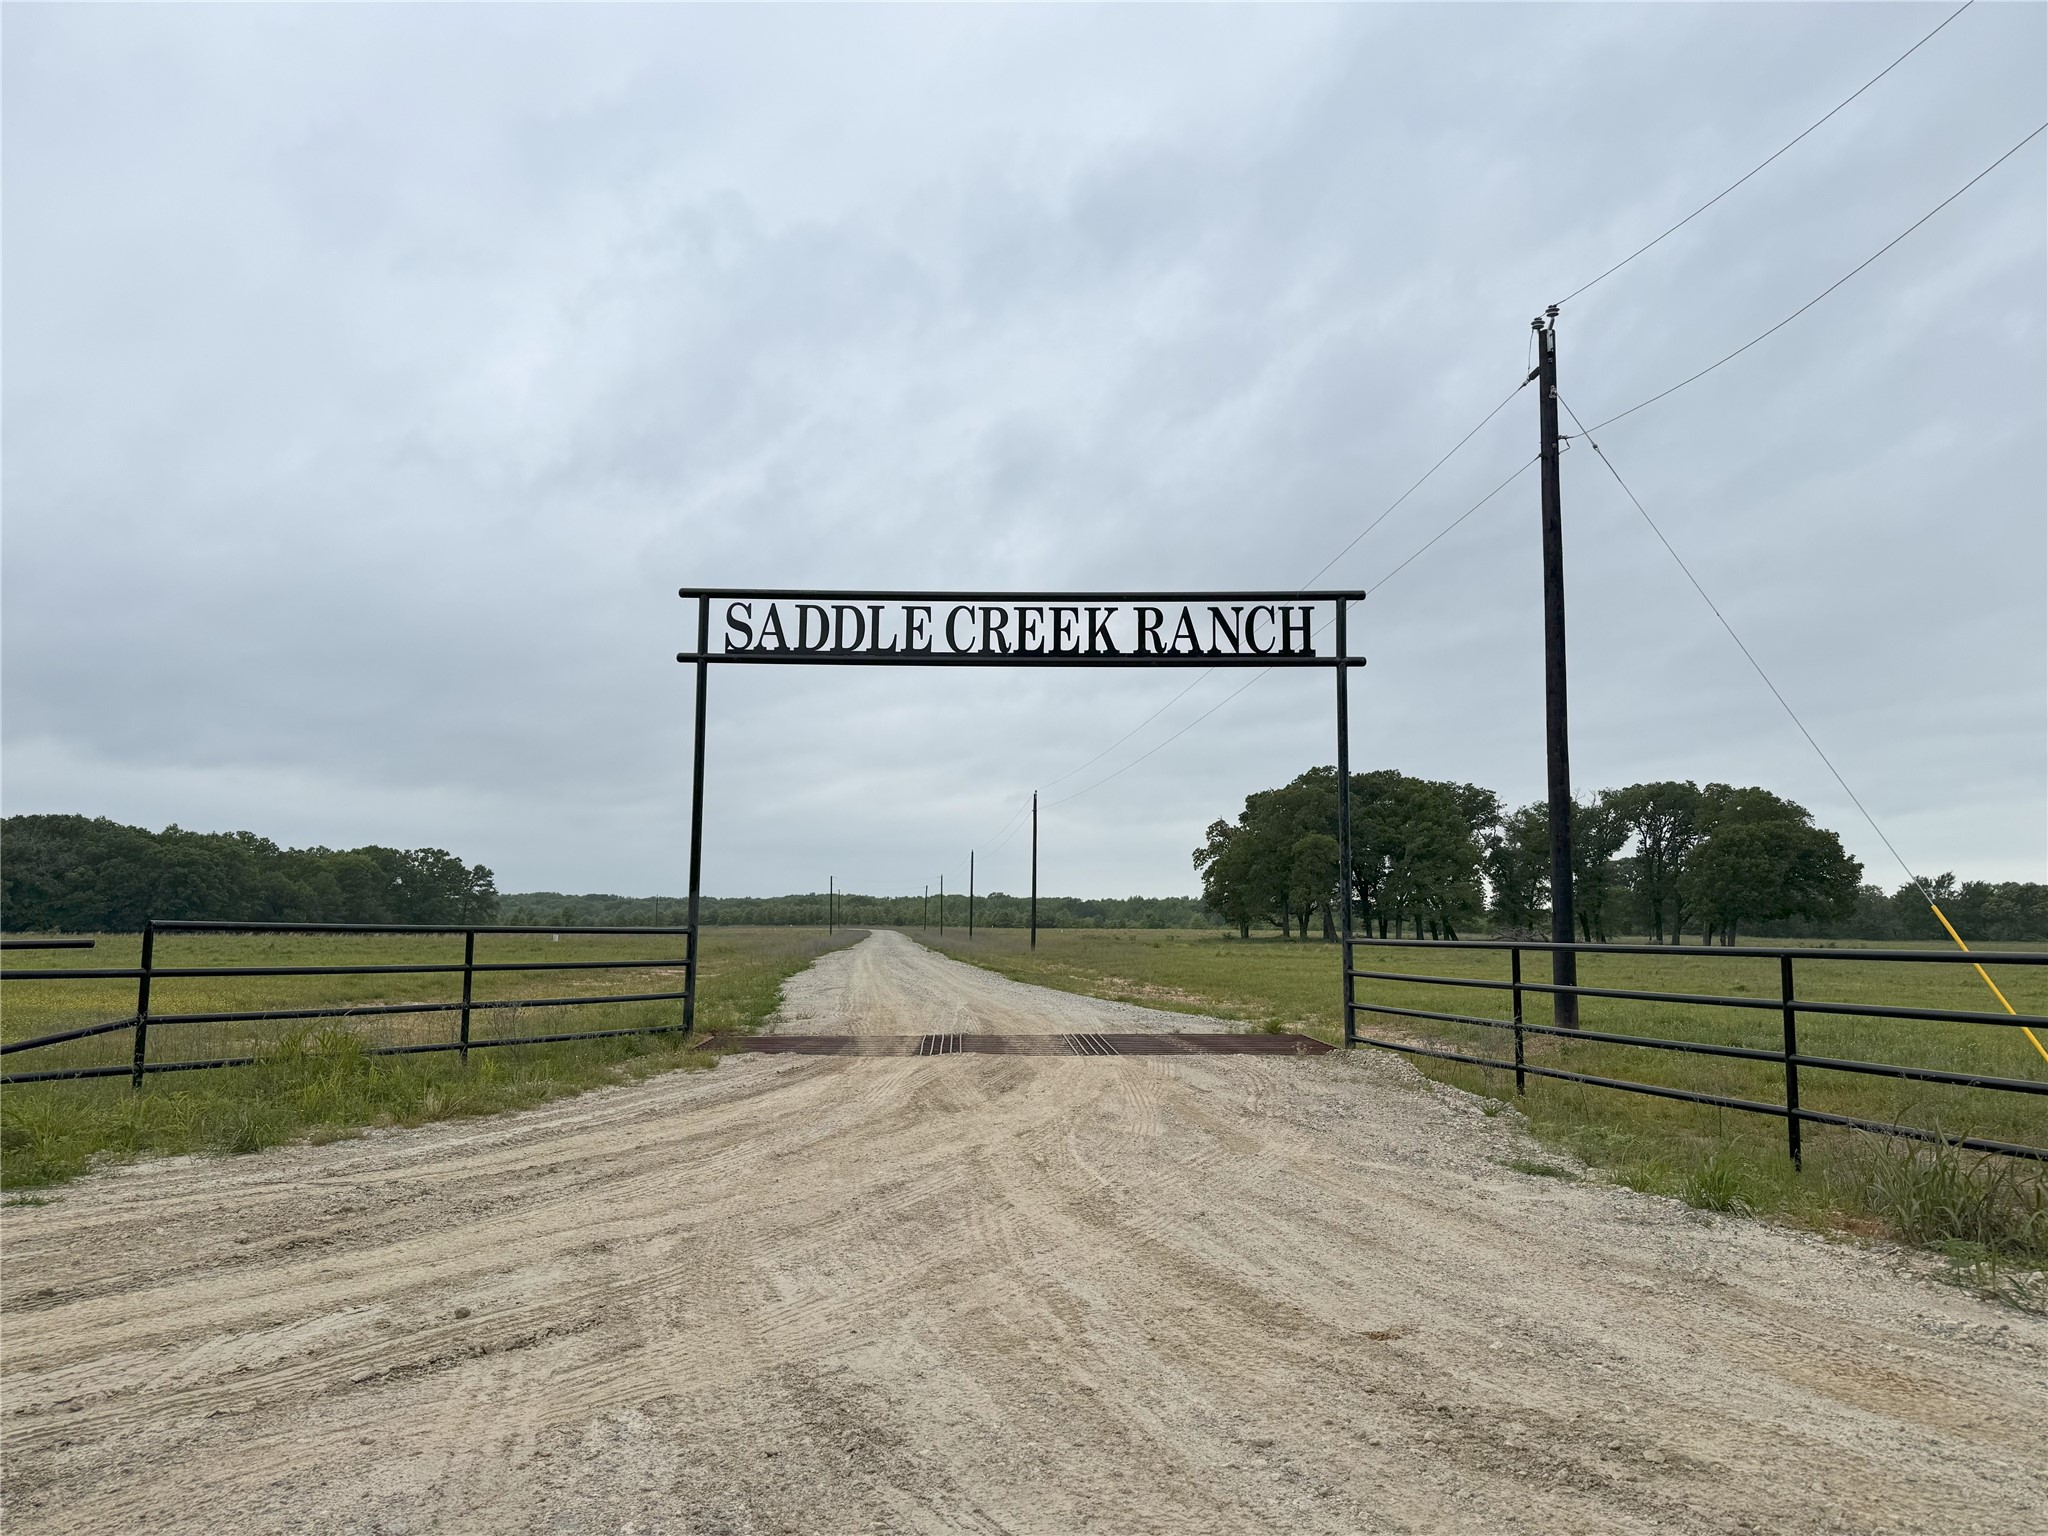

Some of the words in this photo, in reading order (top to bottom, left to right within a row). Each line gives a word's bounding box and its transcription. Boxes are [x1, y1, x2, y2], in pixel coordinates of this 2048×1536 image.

[725, 602, 933, 653] SADDLE
[945, 605, 1120, 654] CREEK
[1133, 605, 1316, 655] RANCH
